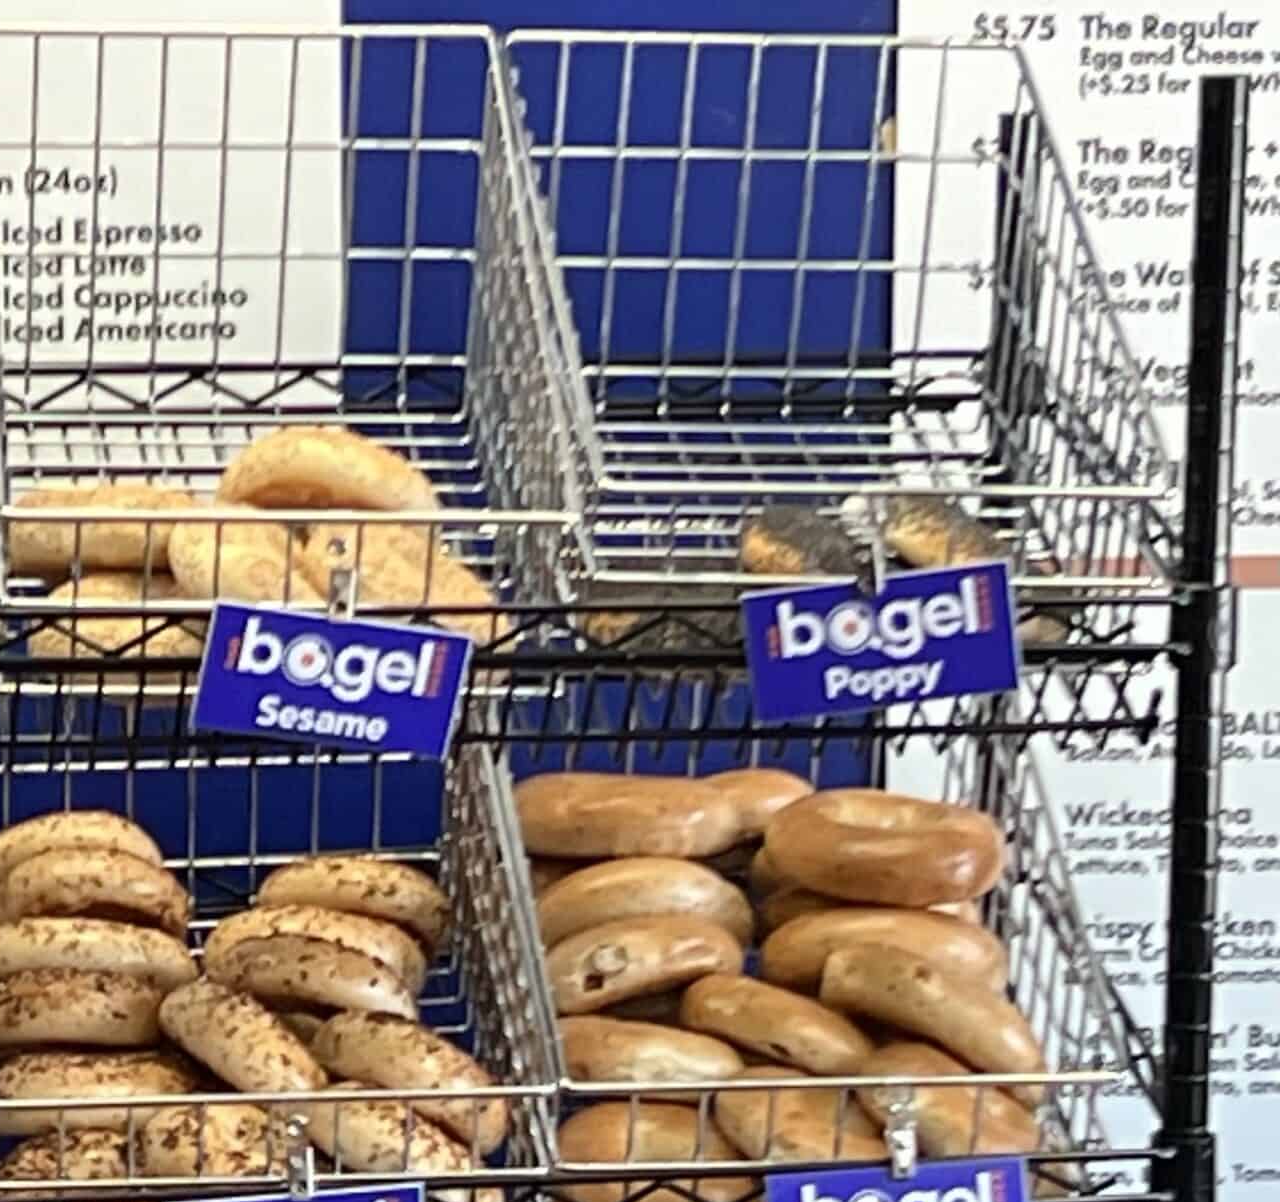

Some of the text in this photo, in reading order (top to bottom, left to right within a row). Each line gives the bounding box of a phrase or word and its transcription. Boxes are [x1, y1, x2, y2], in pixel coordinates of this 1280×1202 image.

[973, 12, 1056, 42] $5.75
[1079, 11, 1260, 50] The Regular
[1079, 45, 1264, 71] Egg and Cheese
[1158, 72, 1191, 93] for
[1077, 138, 1128, 165] The
[24, 166, 118, 198] (24oz)
[1078, 170, 1172, 196] Egg and
[1156, 196, 1189, 218] for
[3, 217, 63, 244] Iced
[73, 217, 202, 249] Espresso
[3, 281, 249, 315] Iced Cappuccino
[4, 318, 237, 343] Iced Americano
[824, 659, 945, 701] Poppy
[255, 694, 389, 742] Sesame
